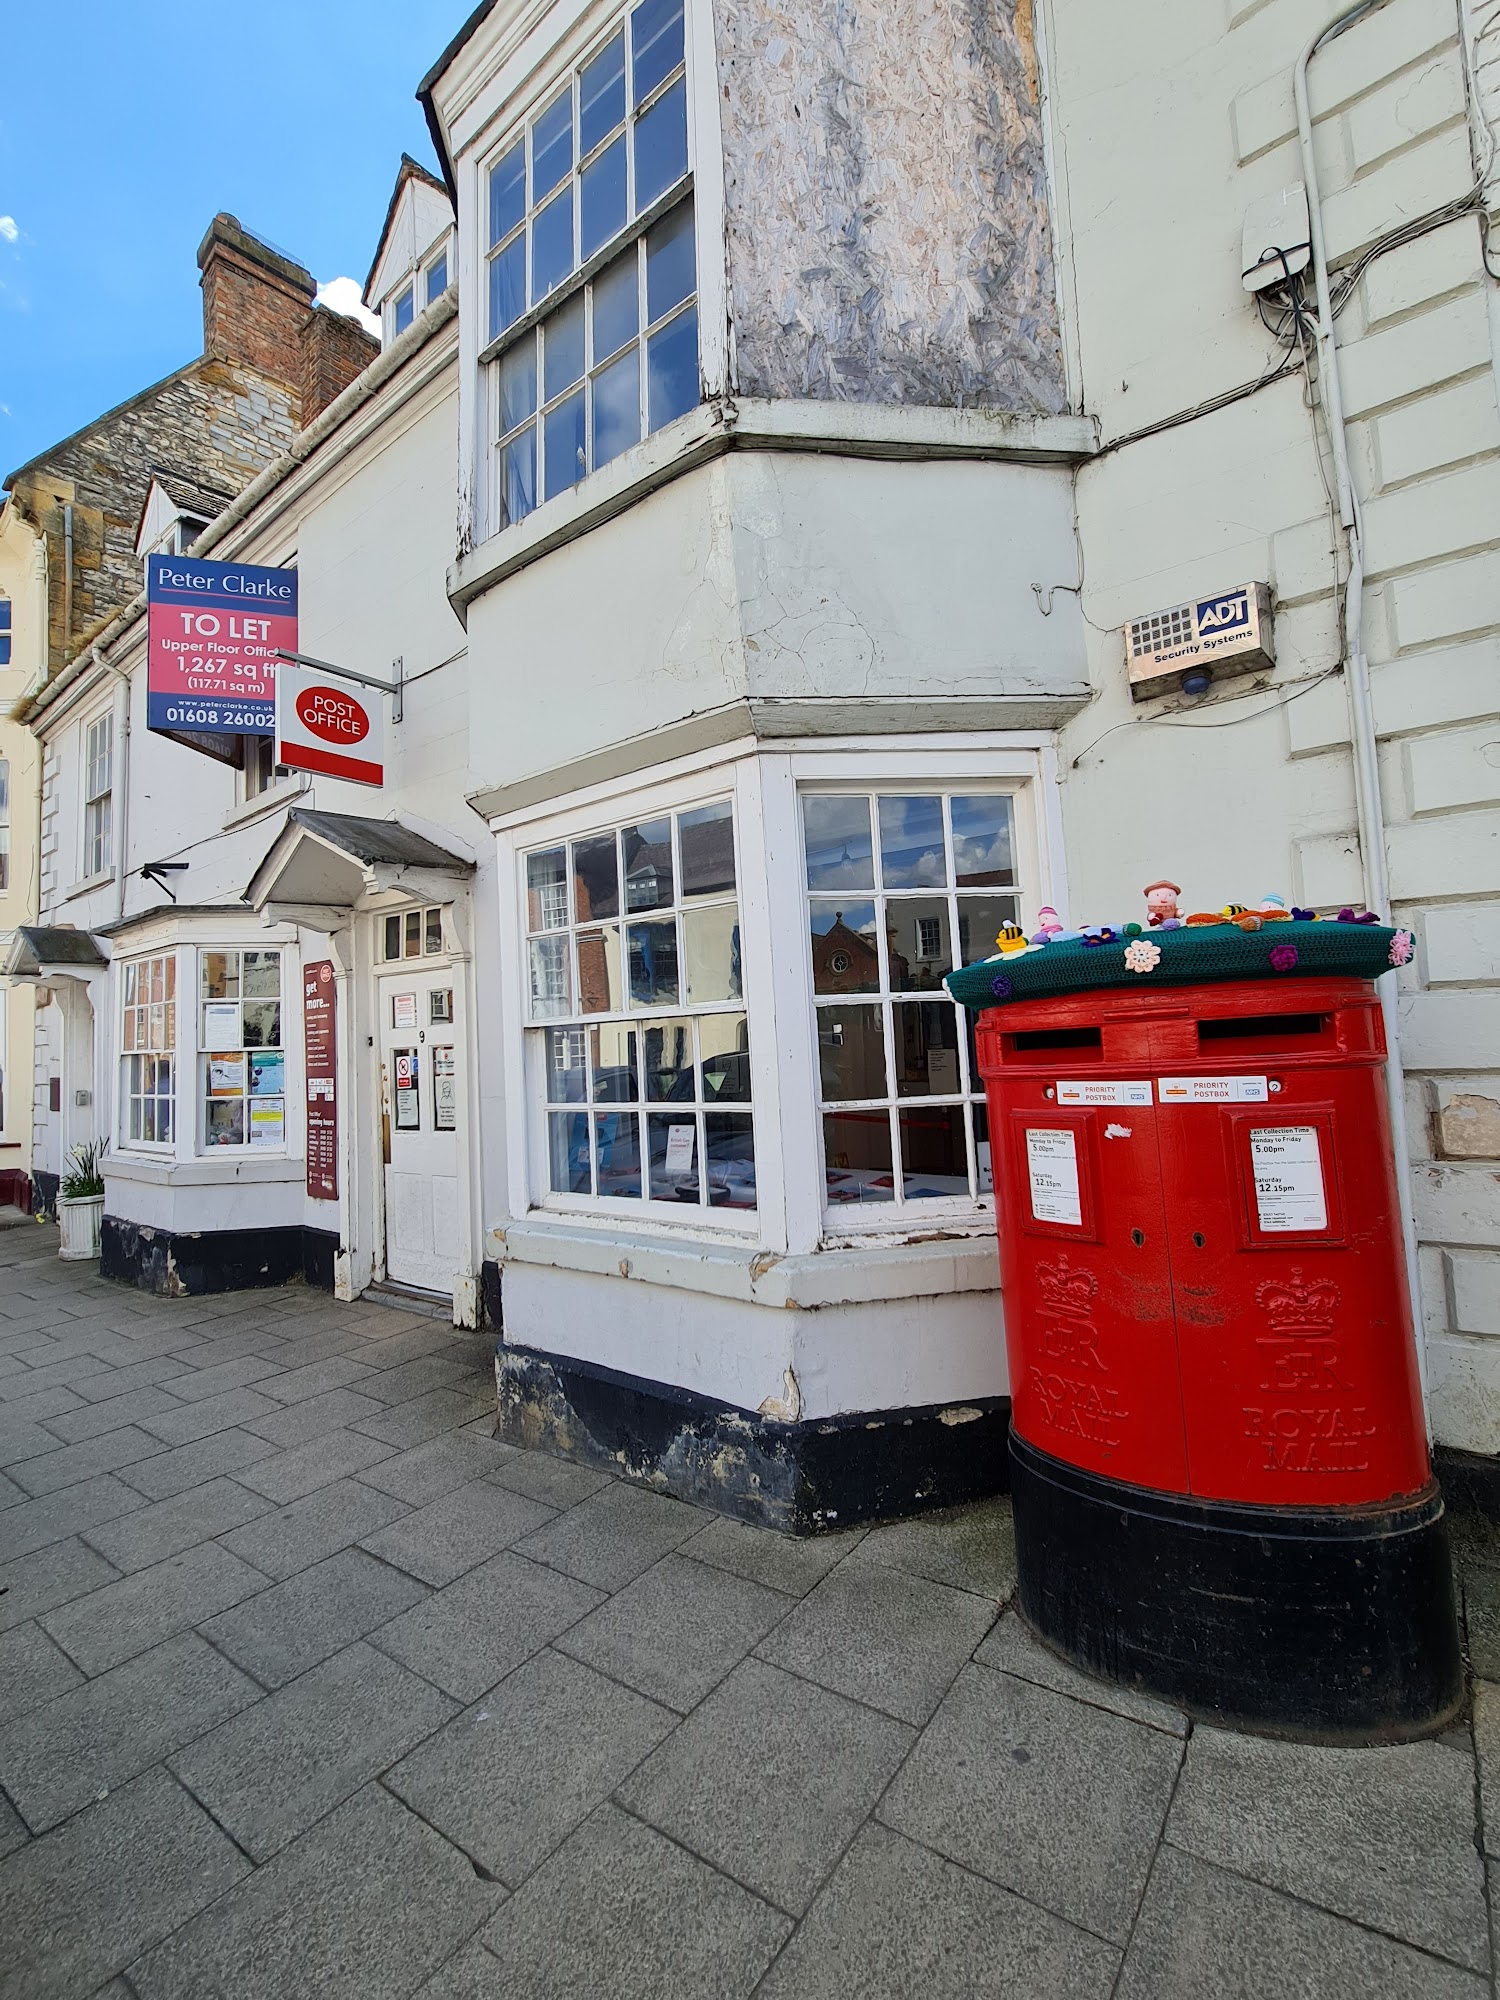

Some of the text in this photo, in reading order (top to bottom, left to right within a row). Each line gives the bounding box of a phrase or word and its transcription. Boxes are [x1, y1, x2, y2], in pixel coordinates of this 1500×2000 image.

[159, 568, 292, 599] Peter Clarke
[1199, 599, 1244, 631] ADT
[180, 612, 271, 641] TO LET
[161, 638, 276, 658] Upper Floor Offic
[1154, 630, 1253, 663] Security Systems
[177, 655, 227, 675] 1,267
[233, 663, 257, 680] sq
[187, 676, 265, 695] (117.71 sq m)
[178, 700, 273, 712] www.peterclarke.co.uk
[314, 695, 356, 713] POST
[166, 707, 276, 728] 01608 26002
[303, 709, 361, 736] OFFICE
[306, 980, 317, 997] get
[419, 1030, 425, 1043] 9
[1033, 1144, 1054, 1153] 5.00pm
[1255, 1144, 1285, 1153] 5.00pm
[1035, 1178, 1061, 1188] 12.15pm
[1259, 1183, 1295, 1192] 12.15pm
[1030, 1365, 1129, 1418] ROYAL
[1040, 1397, 1120, 1446] MAIL
[1242, 1407, 1376, 1438] ROYAL
[1262, 1442, 1368, 1472] MAIL
